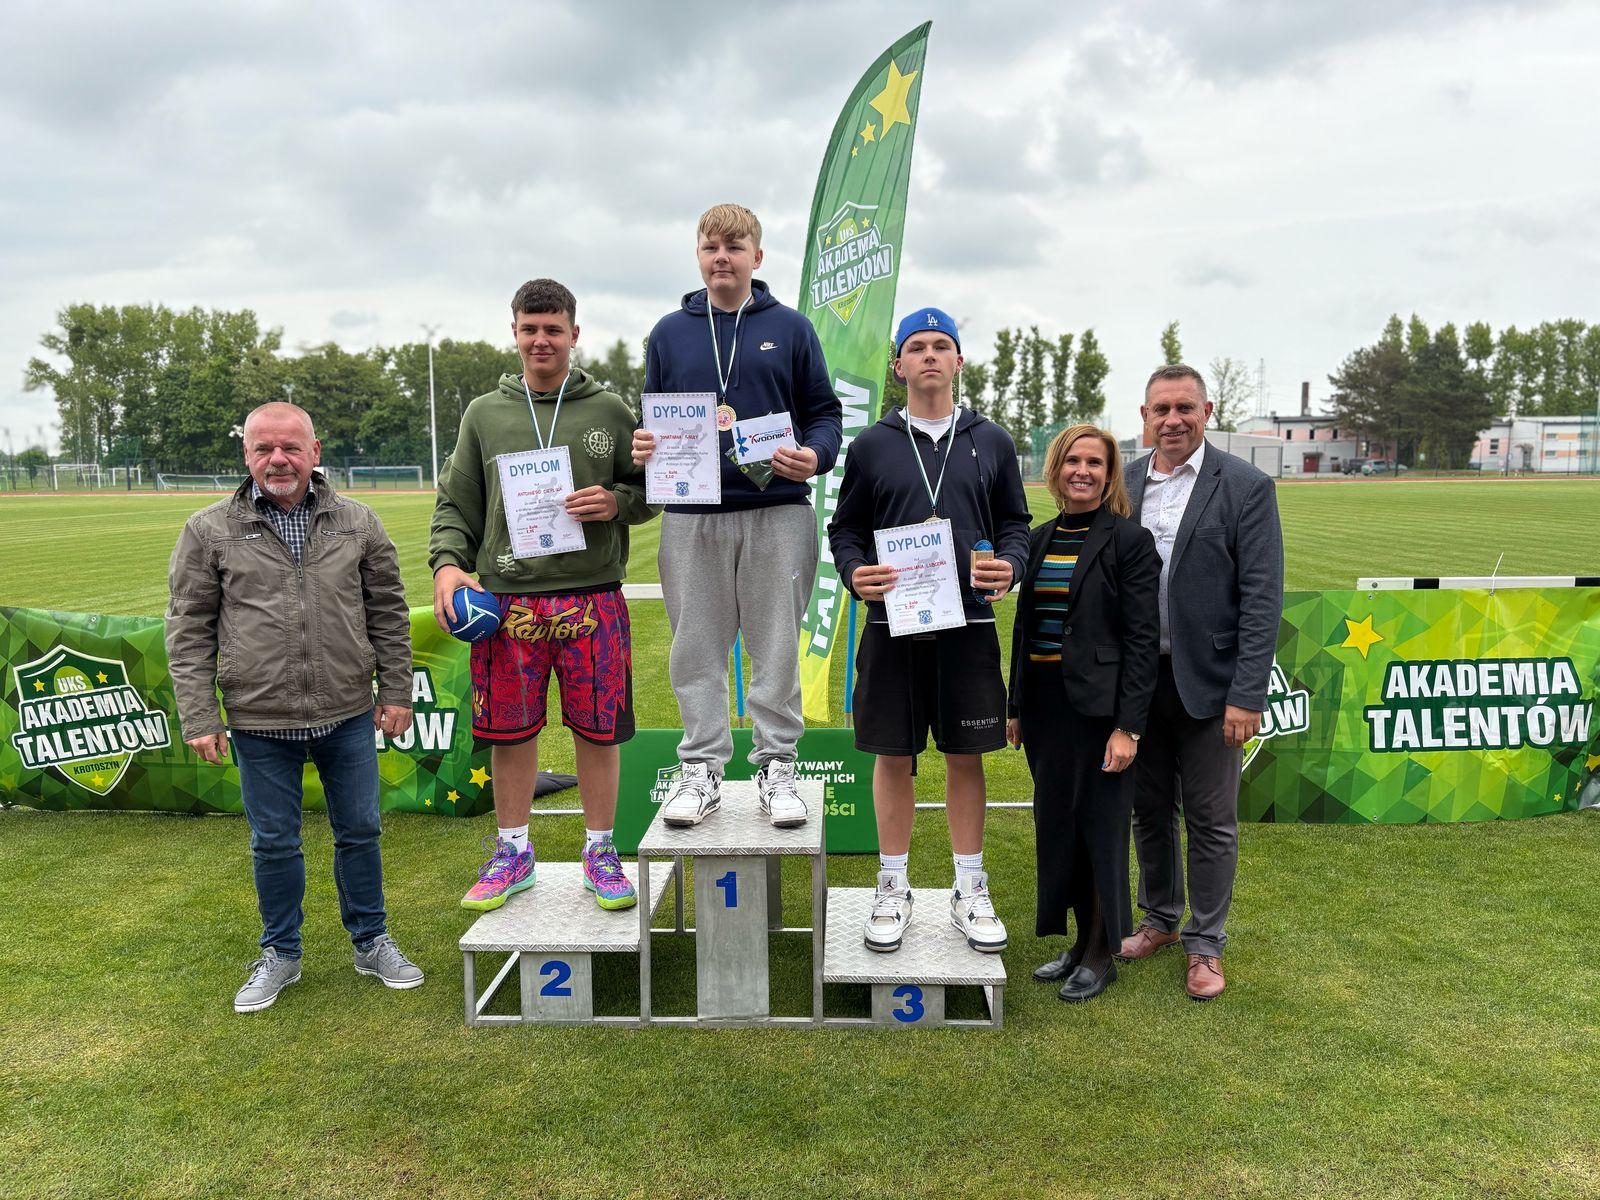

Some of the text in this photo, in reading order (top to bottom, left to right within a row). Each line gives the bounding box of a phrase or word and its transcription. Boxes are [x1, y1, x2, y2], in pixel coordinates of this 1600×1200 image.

[817, 229, 880, 276] AKADEMA
[927, 313, 938, 326] LA
[653, 405, 706, 418] DYPLOM
[509, 459, 560, 477] DYPLOM
[887, 533, 942, 553] DYPLOM
[57, 675, 87, 693] UKS
[1386, 661, 1579, 699] AKADEMIA
[24, 690, 142, 729] AKADEMIA
[961, 716, 999, 727] ESSENTIALS
[1367, 697, 1593, 749] TALENTÓW
[17, 715, 166, 764] TALENTÓW
[73, 761, 120, 775] KROTOSZYN
[795, 761, 844, 770] YWAMY
[834, 773, 855, 783] ICH
[715, 871, 737, 908] 1
[539, 960, 572, 997] 2
[892, 985, 925, 1023] 3
